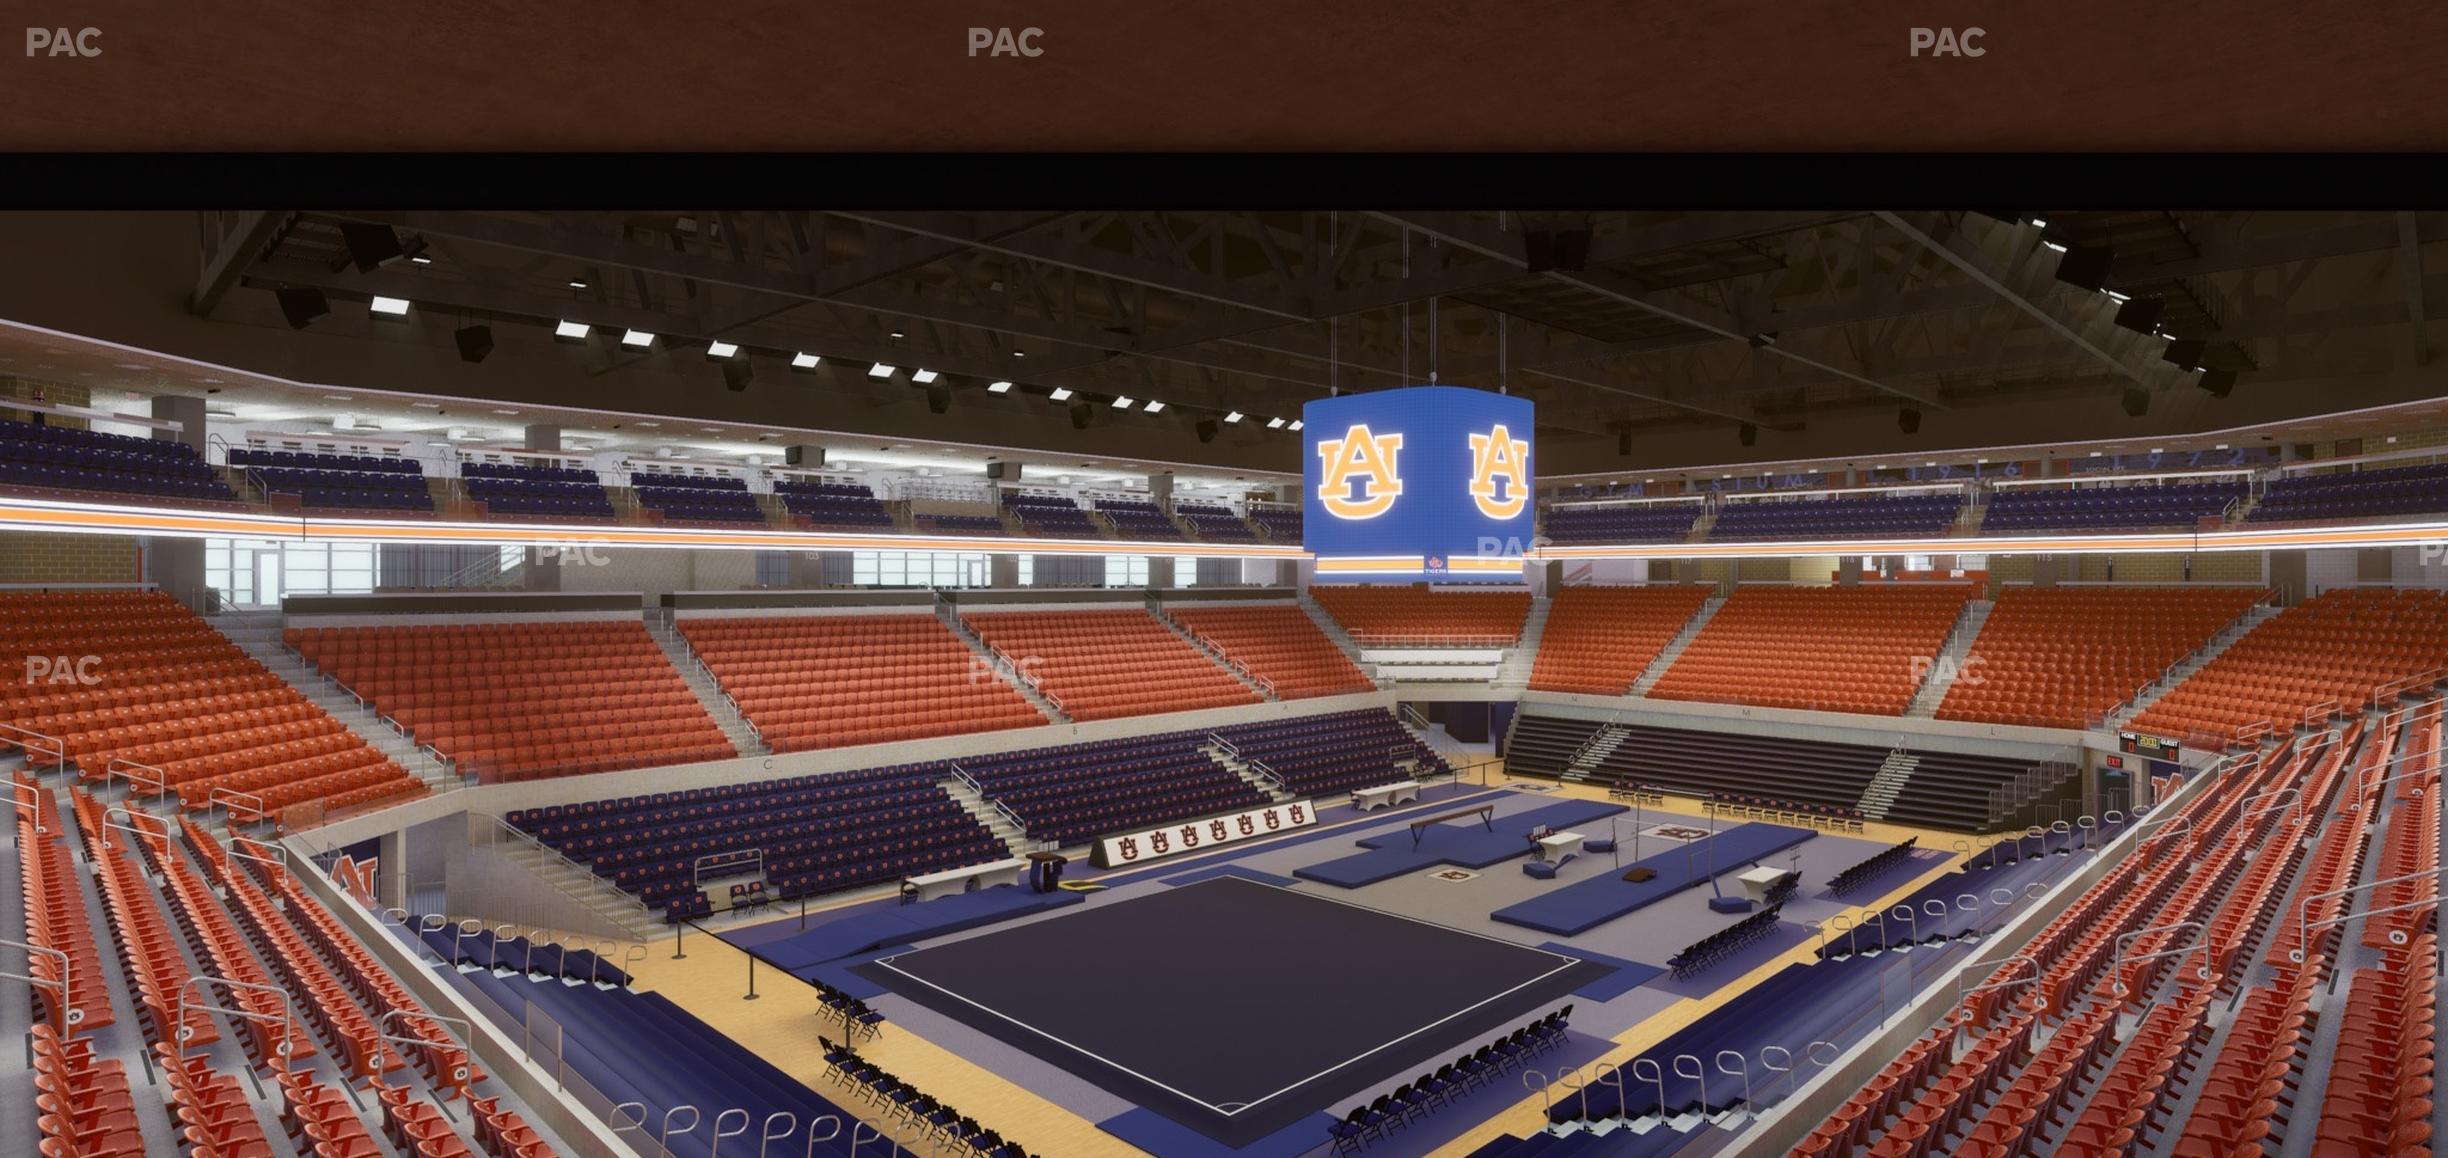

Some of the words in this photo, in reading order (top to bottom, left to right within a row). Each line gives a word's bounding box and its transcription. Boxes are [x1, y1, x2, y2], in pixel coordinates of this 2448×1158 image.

[2121, 732, 2136, 740] HOME
[2160, 738, 2178, 747] GUEST
[2108, 757, 2121, 766] EXIT
